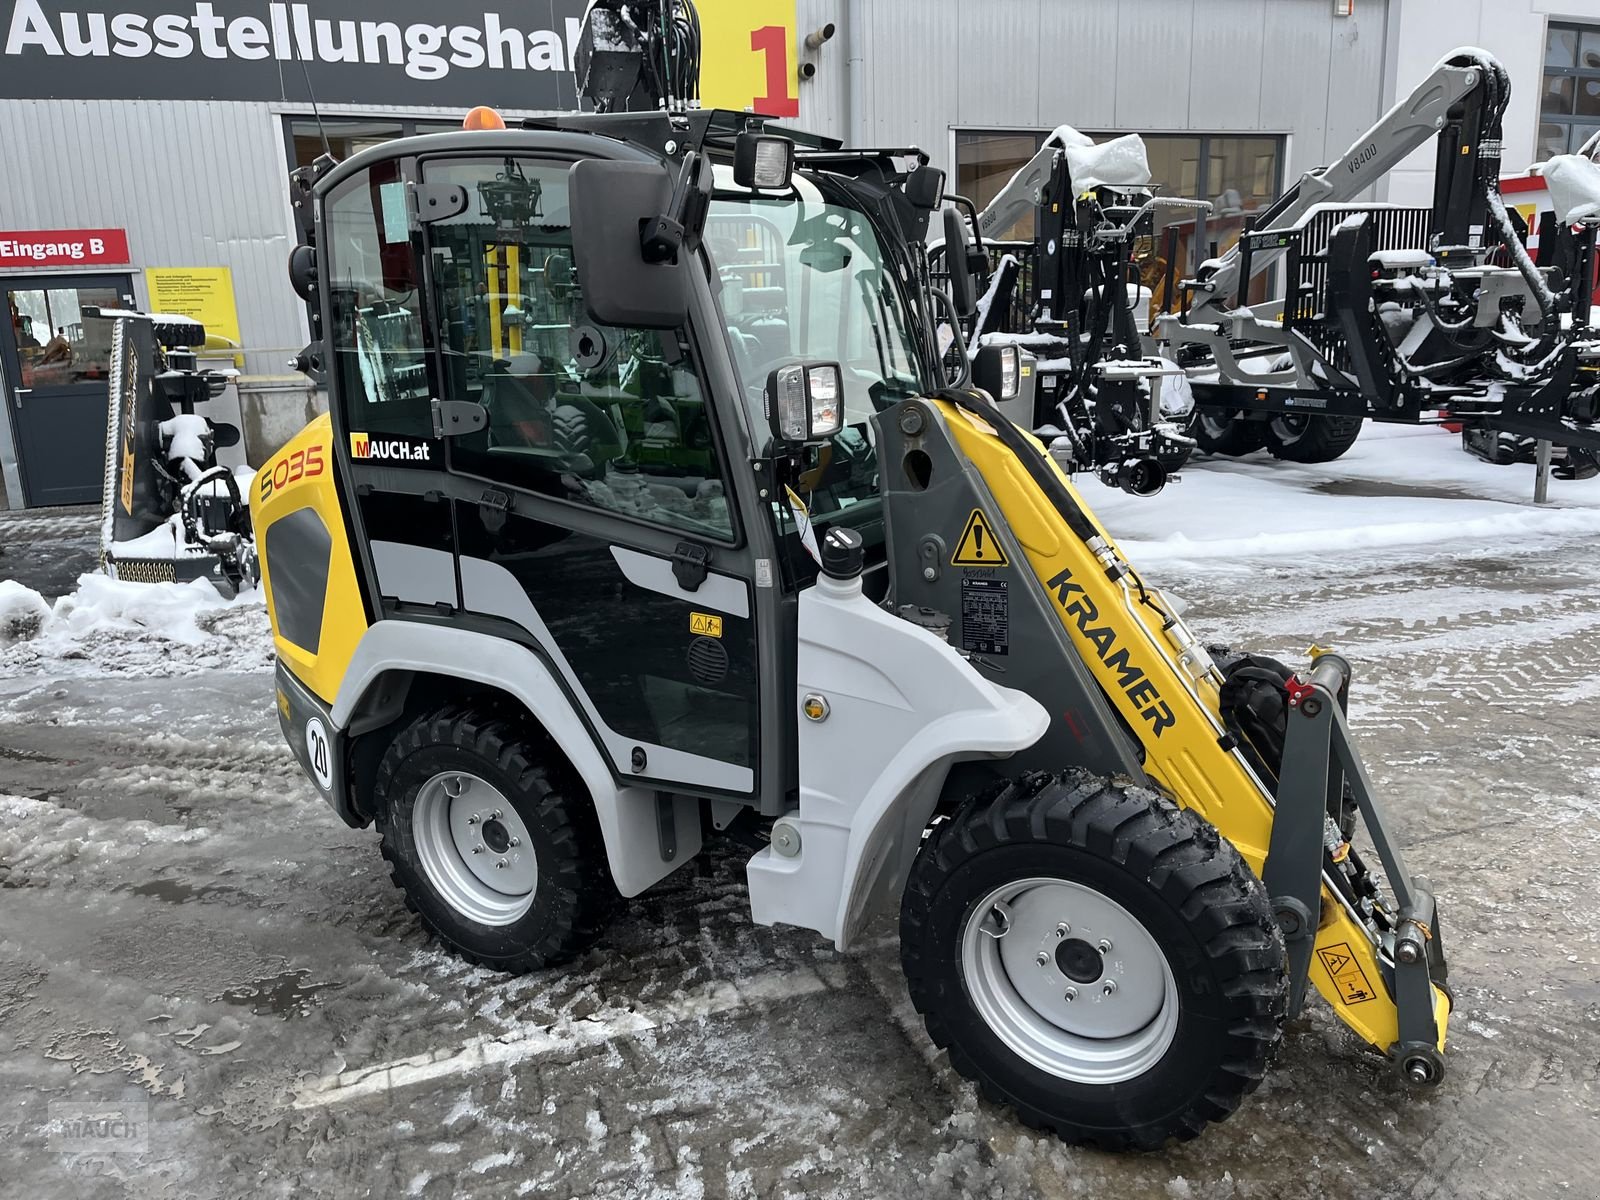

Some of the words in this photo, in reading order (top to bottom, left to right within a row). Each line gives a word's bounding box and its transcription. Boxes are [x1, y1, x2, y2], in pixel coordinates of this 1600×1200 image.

[751, 26, 799, 117] 1
[1348, 143, 1377, 174] V8400
[0, 240, 84, 260] Eingang
[89, 238, 105, 255] B
[261, 445, 324, 503] 5035
[356, 440, 430, 460] MAUCH.at
[1046, 567, 1176, 739] KRAMER
[311, 729, 328, 778] 20
